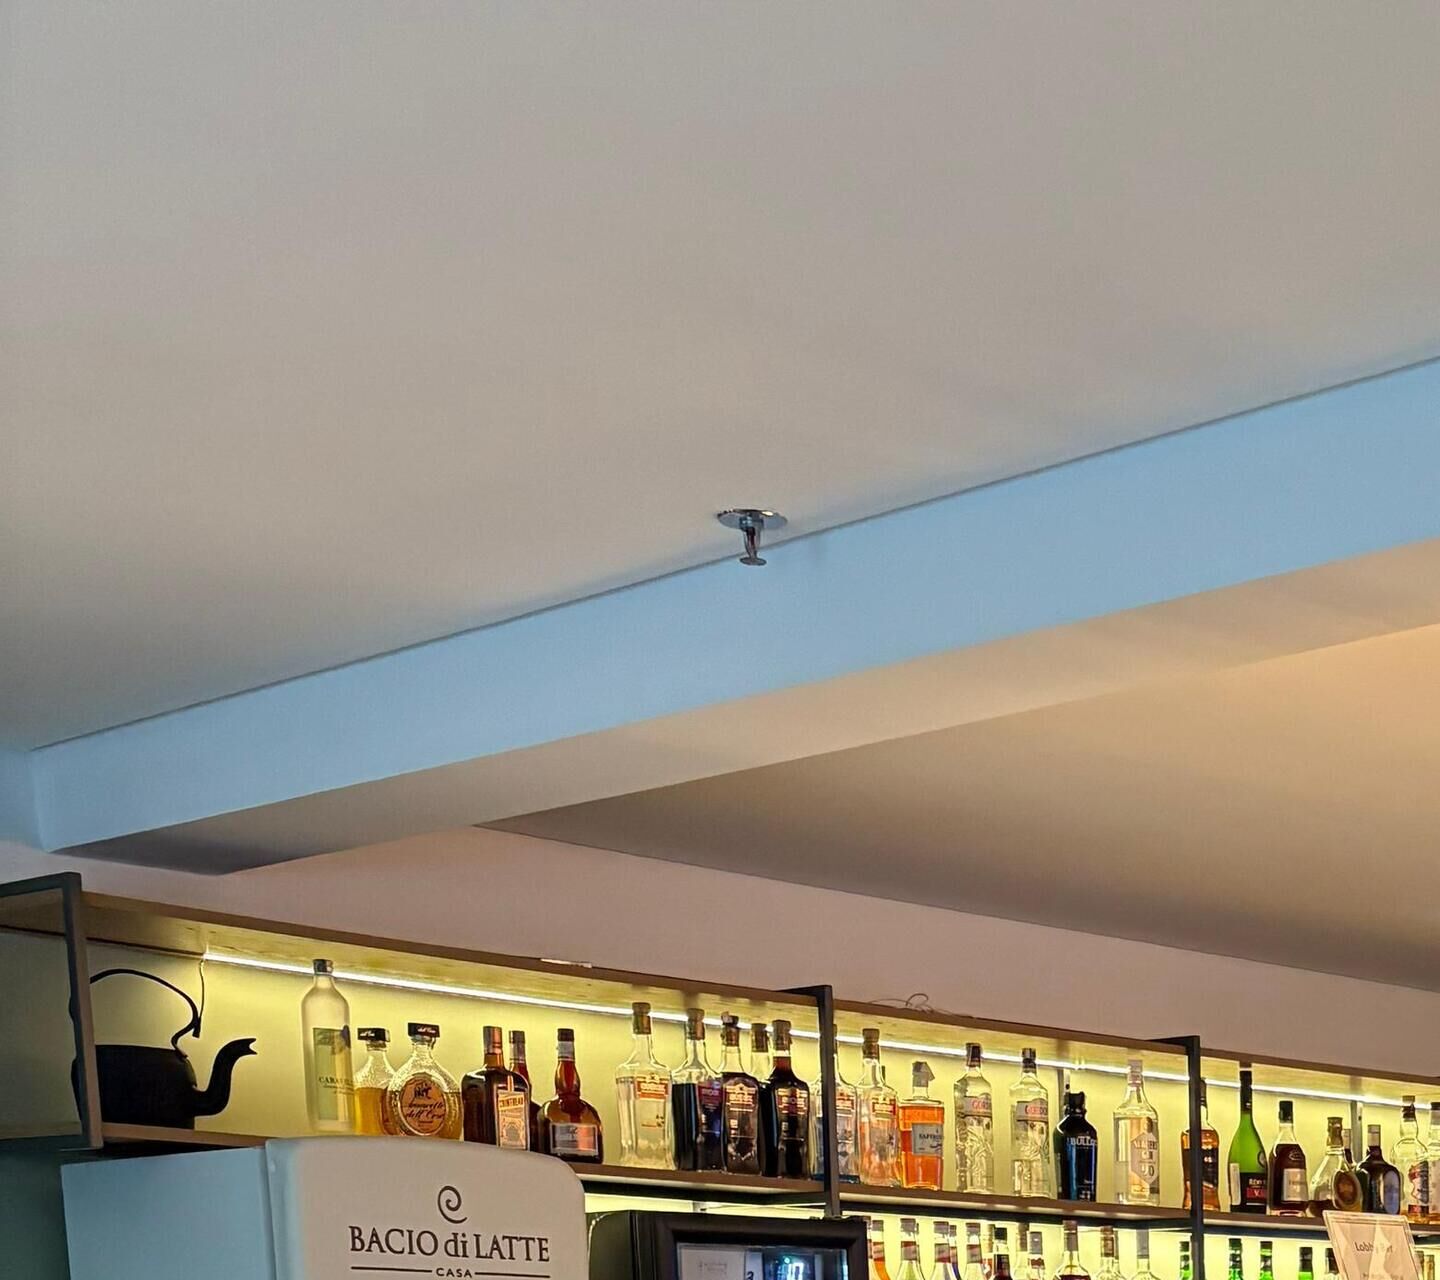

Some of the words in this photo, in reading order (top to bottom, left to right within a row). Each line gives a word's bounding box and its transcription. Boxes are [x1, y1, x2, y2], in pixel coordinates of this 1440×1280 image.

[349, 1226, 439, 1257] BACIO
[444, 1232, 469, 1259] di
[473, 1234, 551, 1263] LATTE
[436, 1267, 473, 1279] CASA
